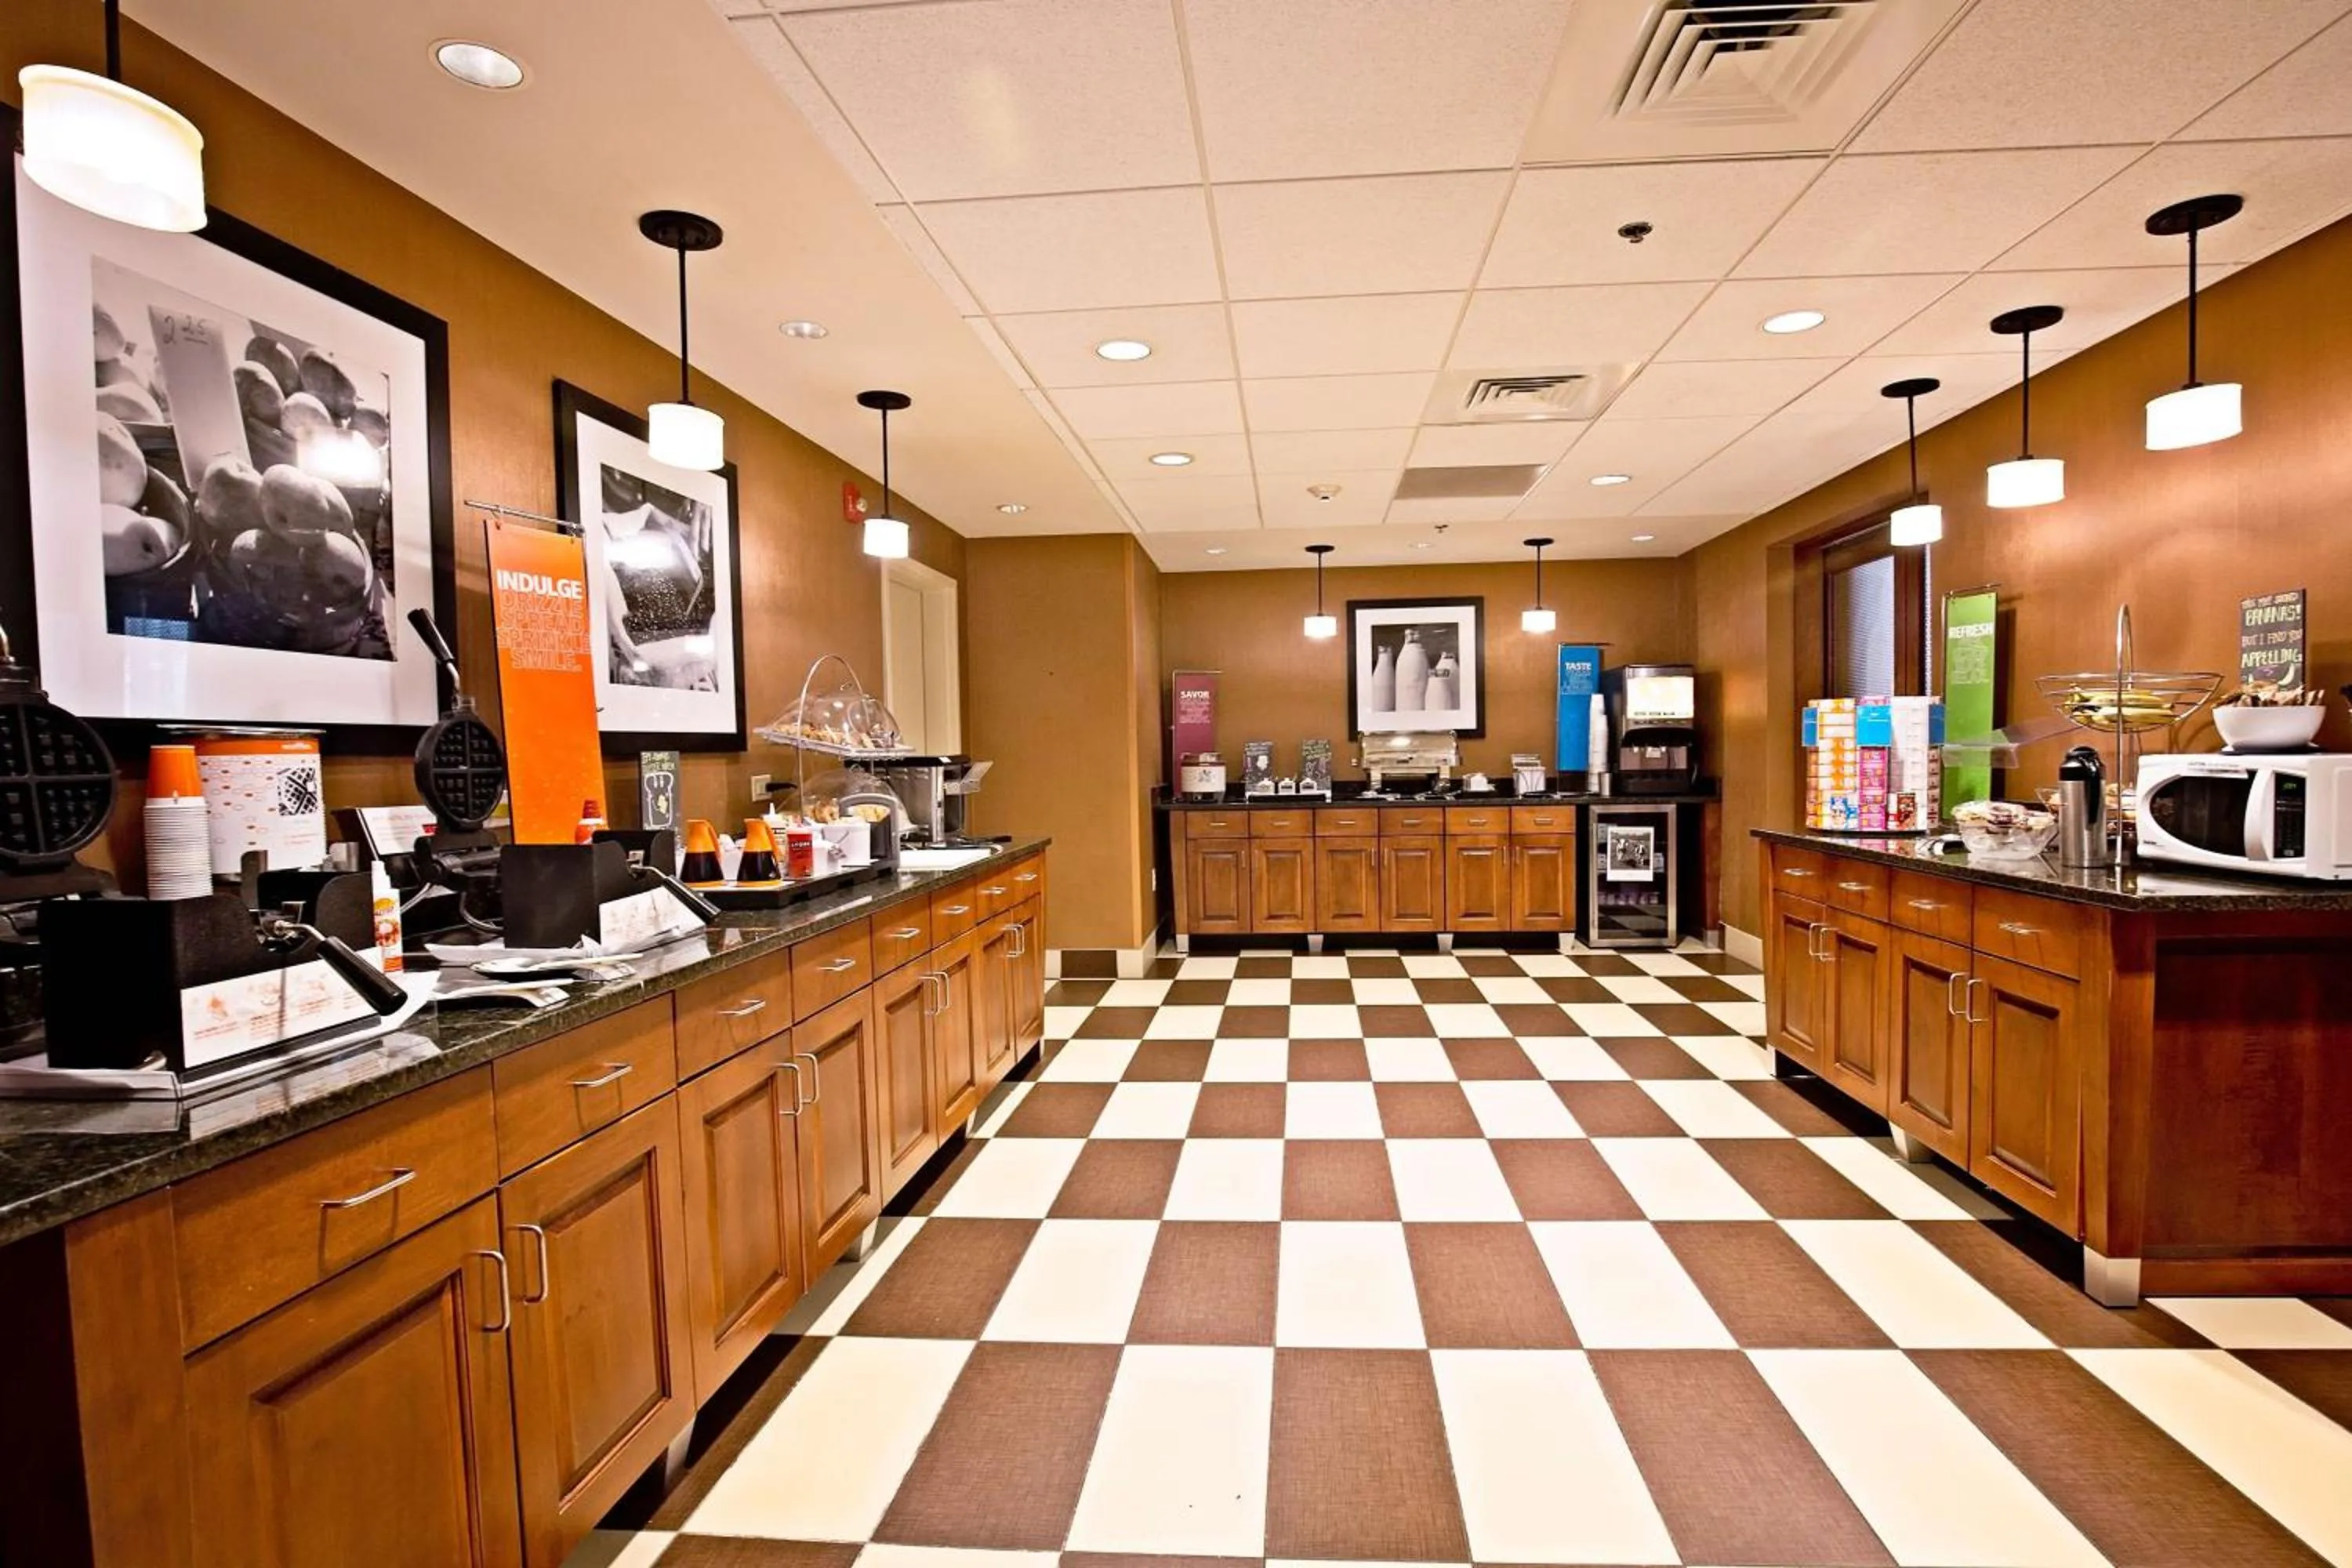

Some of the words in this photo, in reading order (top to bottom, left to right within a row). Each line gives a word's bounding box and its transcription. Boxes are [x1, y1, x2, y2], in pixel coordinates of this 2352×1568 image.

[496, 568, 583, 600] INDULGE
[1565, 662, 1592, 671] TASTE
[1180, 691, 1210, 699] SAVOR
